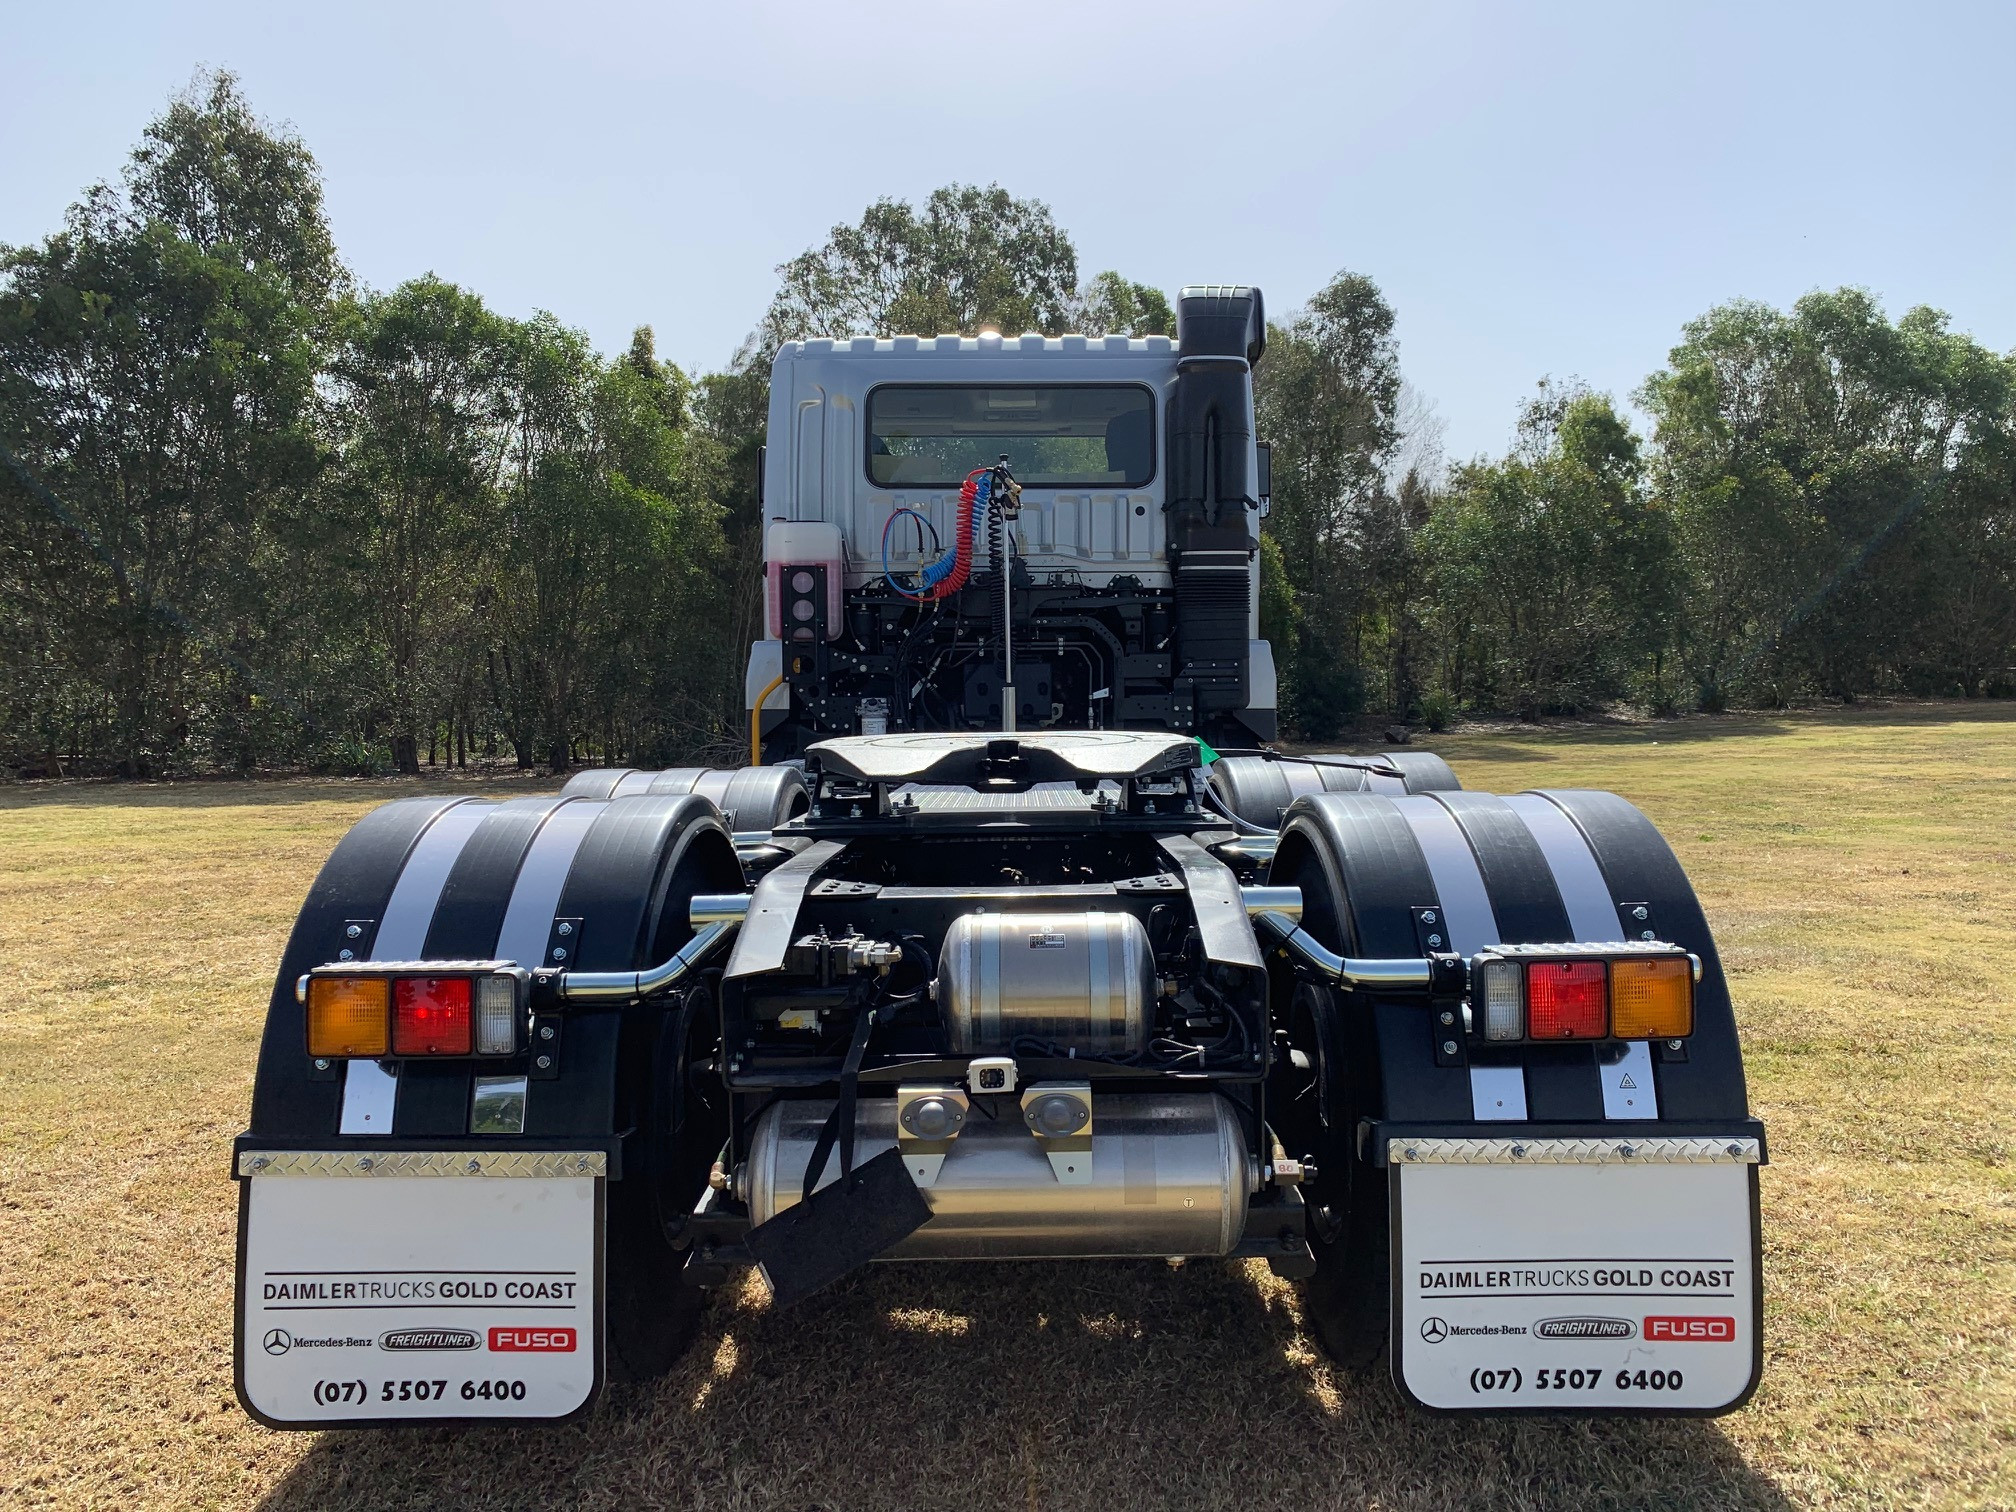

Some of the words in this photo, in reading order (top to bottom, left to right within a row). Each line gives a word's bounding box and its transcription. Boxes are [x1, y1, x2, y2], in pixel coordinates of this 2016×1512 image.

[1593, 1269, 1654, 1287] GOLD
[1660, 1269, 1735, 1287] COAST
[438, 1281, 498, 1299] GOLD
[504, 1281, 577, 1299] COAST
[1449, 1324, 1528, 1336] Mercedes-Benz
[1543, 1322, 1627, 1335] FREIGHTLINER
[1653, 1321, 1727, 1337] FUSO
[293, 1336, 373, 1348] Mercedes-Benz
[389, 1334, 472, 1347] FREIGHTLINER
[497, 1332, 569, 1347] FUSO
[1469, 1367, 1523, 1394] (07)
[1535, 1369, 1603, 1390] 5507
[1615, 1369, 1684, 1390] 6400
[313, 1379, 368, 1407] (07)
[381, 1380, 448, 1401] 5507
[460, 1380, 527, 1401] 6400
